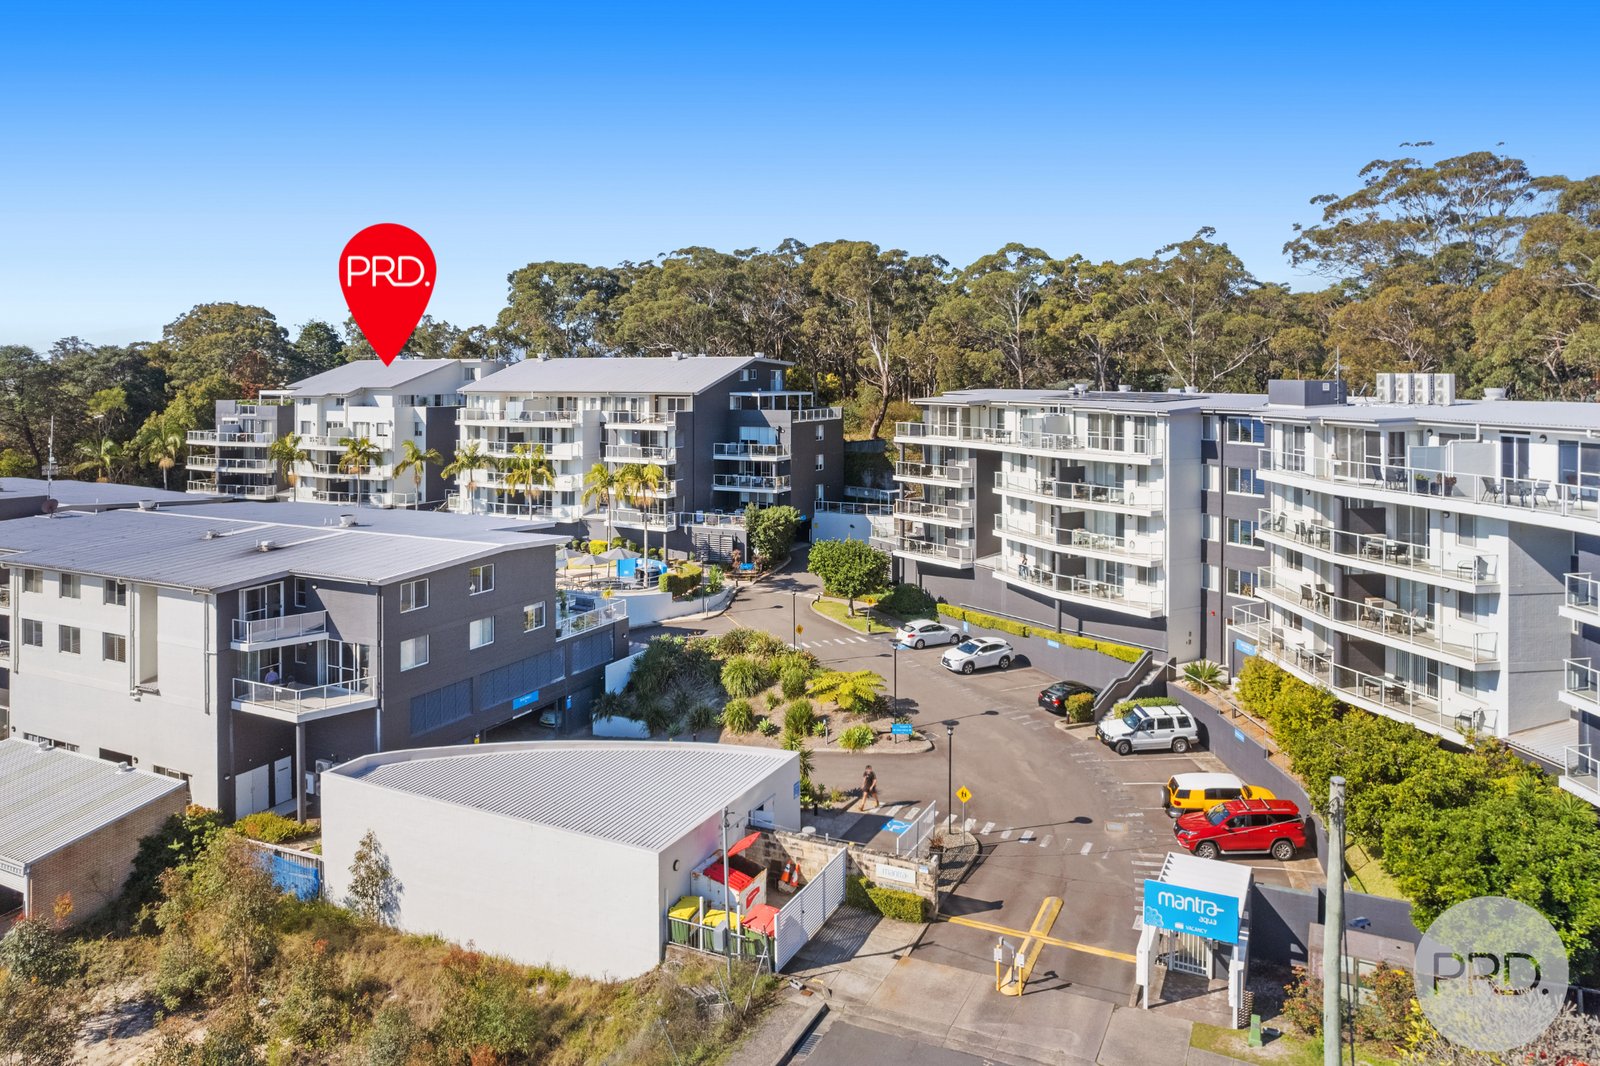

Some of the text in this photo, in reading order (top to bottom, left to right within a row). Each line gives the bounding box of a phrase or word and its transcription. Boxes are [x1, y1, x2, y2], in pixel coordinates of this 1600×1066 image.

[1158, 891, 1224, 917] mantra
[1199, 916, 1217, 926] aqua
[1185, 925, 1208, 934] VACANCY
